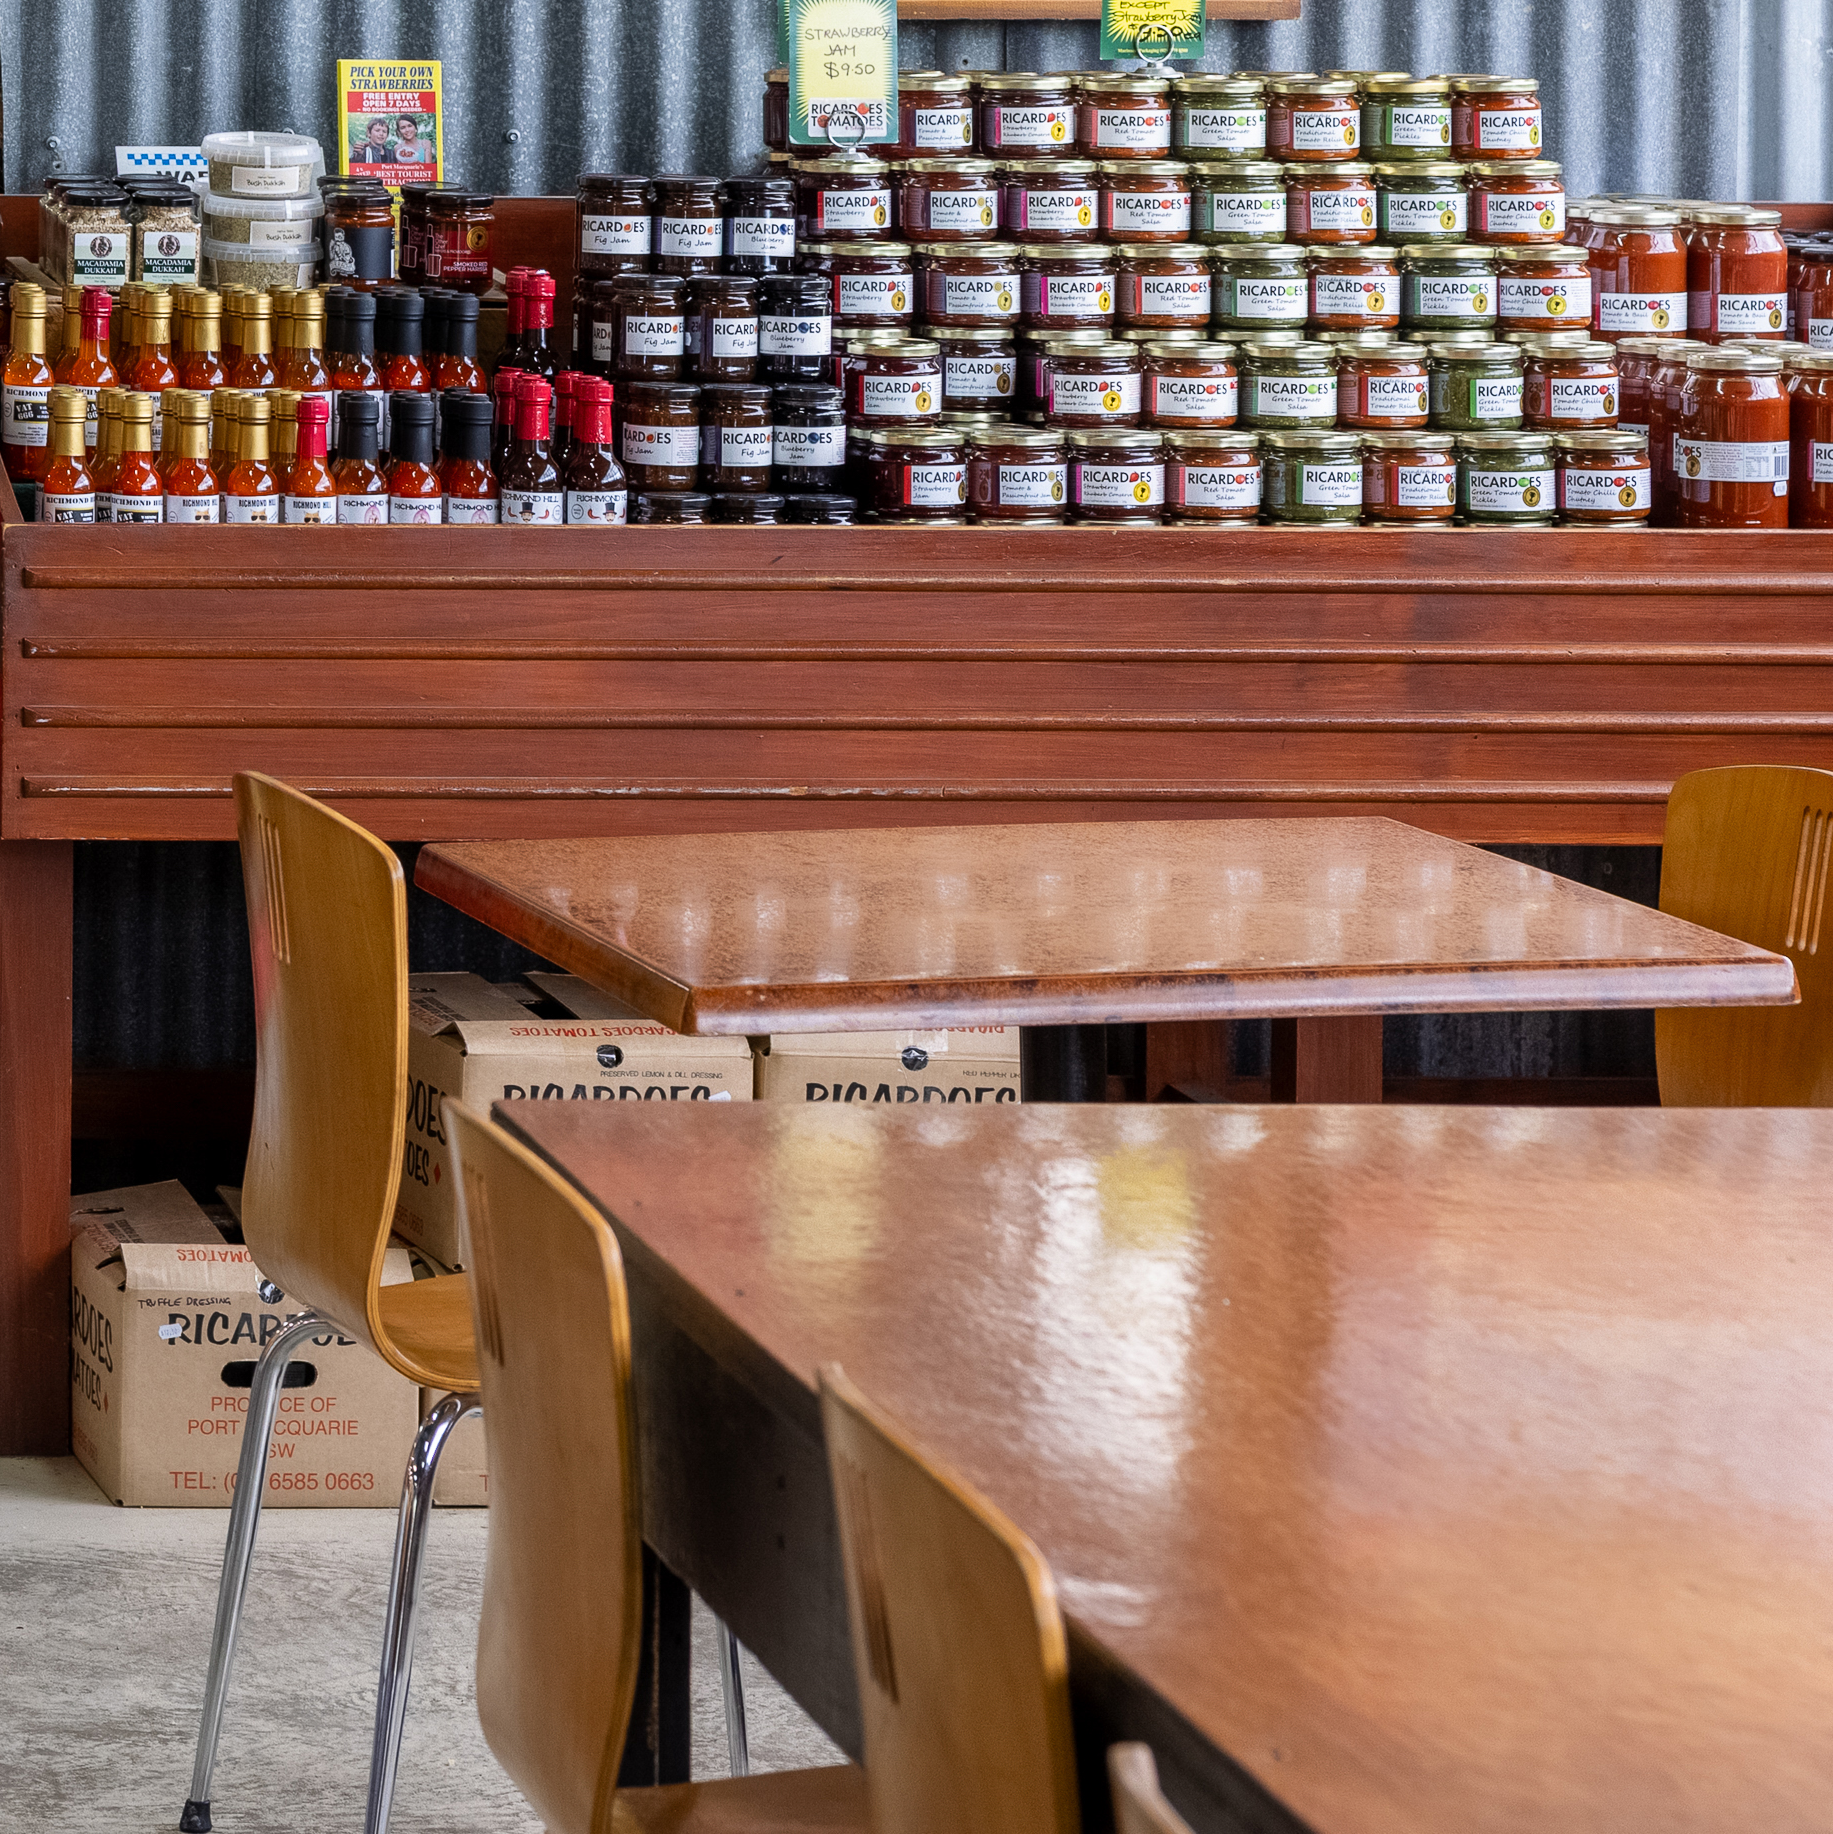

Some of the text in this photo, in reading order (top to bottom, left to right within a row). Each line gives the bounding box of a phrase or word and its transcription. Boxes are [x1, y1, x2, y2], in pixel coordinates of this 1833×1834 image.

[1120, 1, 1171, 10] EXCEPT
[804, 25, 891, 41] STRAWBERRY
[824, 45, 856, 57] JAM
[350, 66, 434, 78] PICK YOUR OWN
[350, 79, 434, 90] STRAWBERRIES
[388, 92, 419, 100] ENTRY
[1114, 127, 1129, 135] Red
[401, 170, 433, 178] TOURIST
[825, 209, 866, 218] Strawberry
[594, 235, 632, 245] Fig Jam
[751, 236, 785, 245] Blueberry
[77, 260, 124, 268] MACADAMIA
[1471, 488, 1523, 496] Green Tomato
[576, 494, 620, 503] RICHMOND
[1471, 496, 1498, 504] Pickles
[599, 1070, 639, 1078] PRESERVED
[691, 1072, 723, 1080] DRESSING
[137, 1296, 232, 1309] TRUFFLE DRESSING
[310, 1397, 337, 1413] OF
[187, 1420, 241, 1436] PORT
[169, 1472, 375, 1490] TEL: 6585 0663
